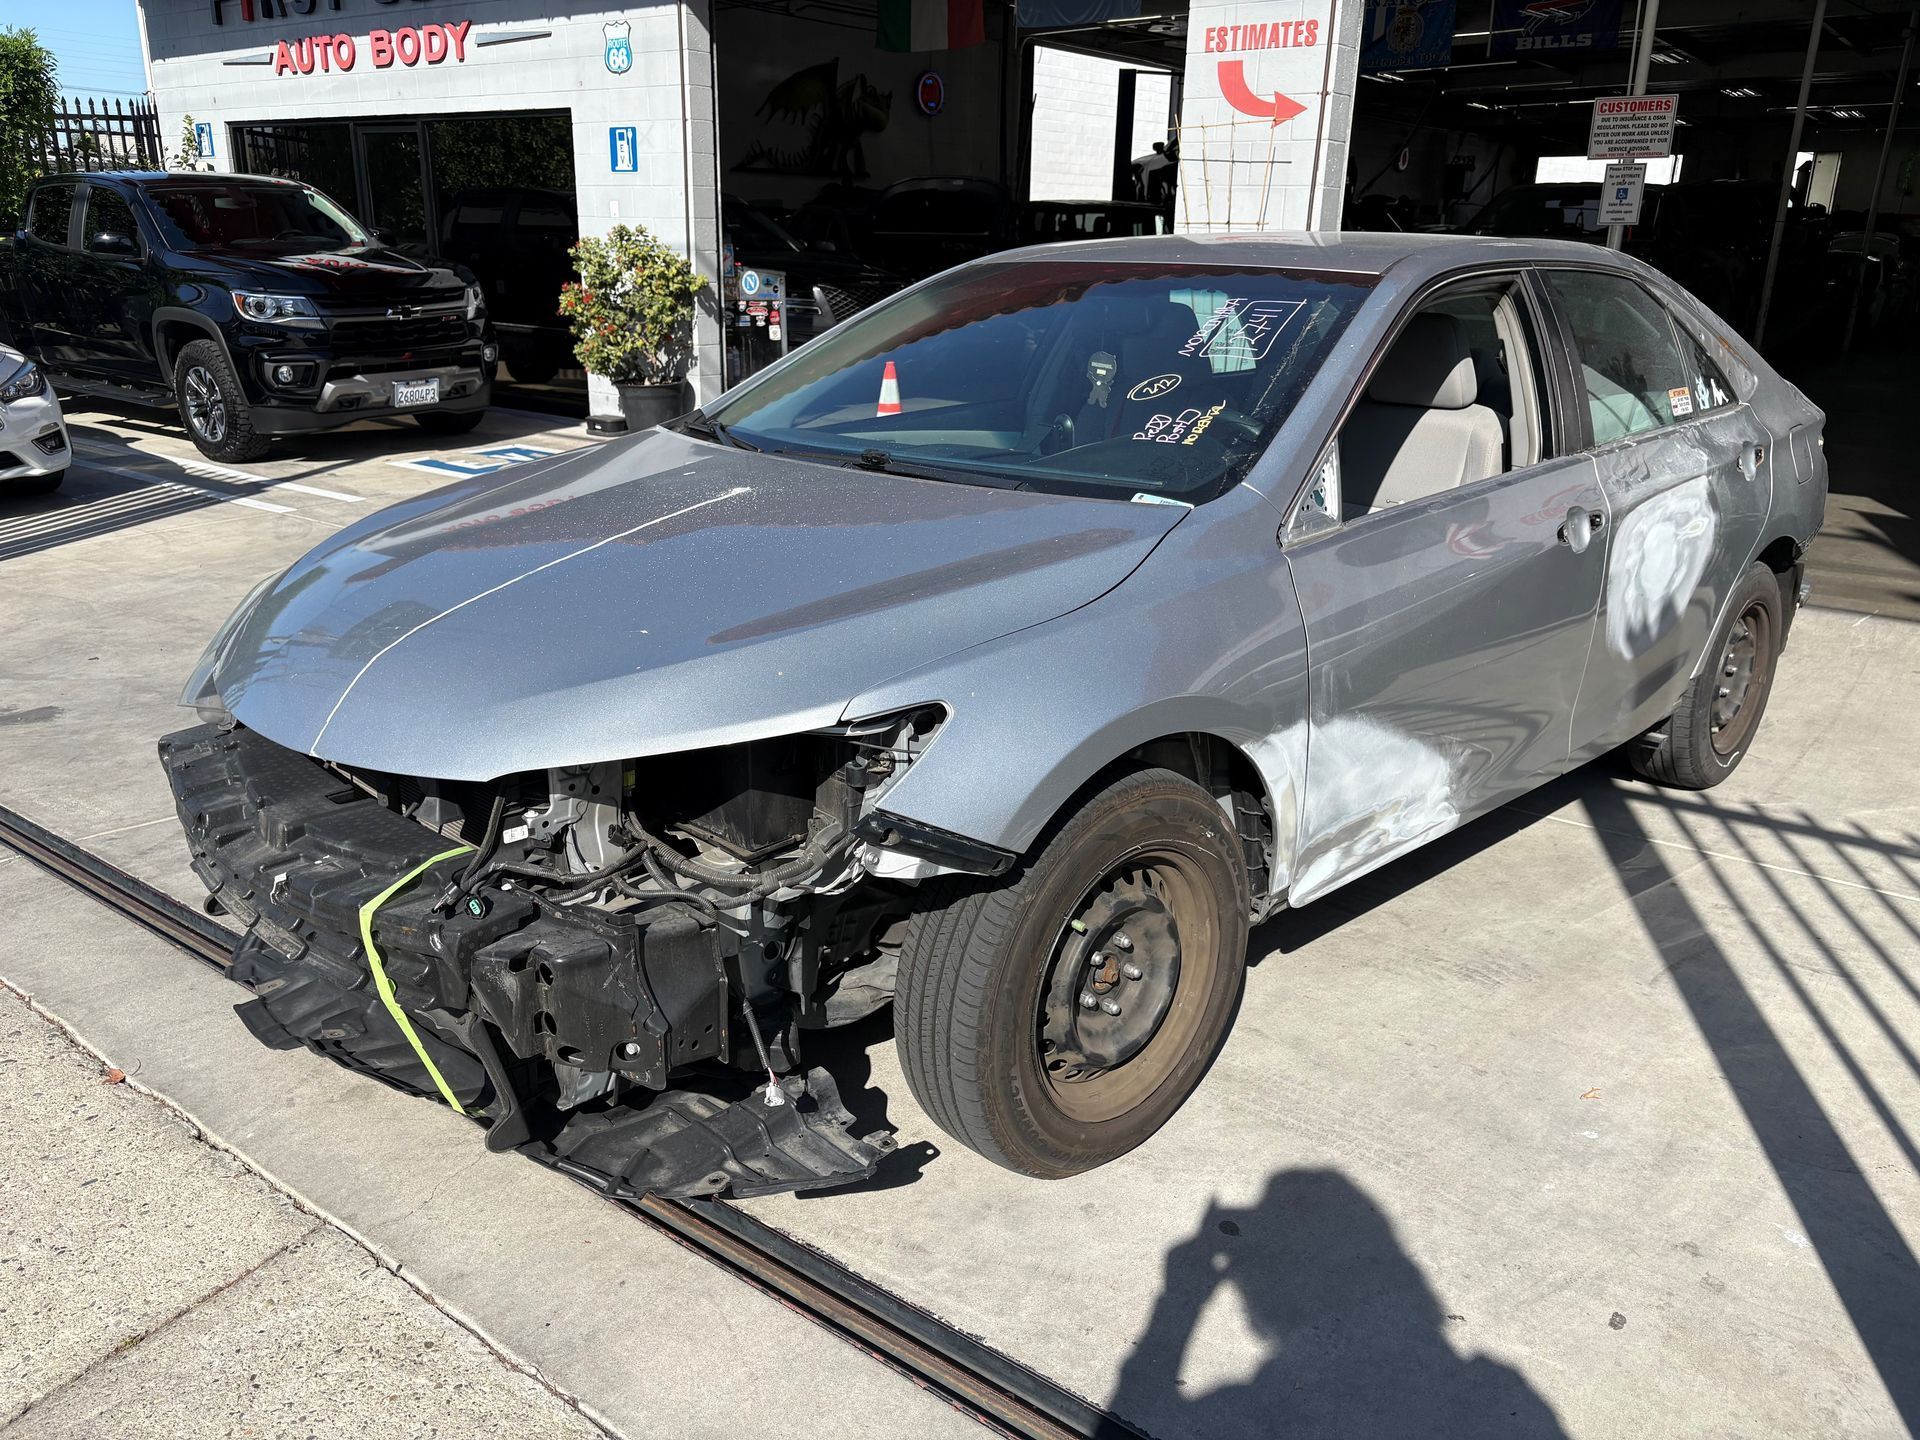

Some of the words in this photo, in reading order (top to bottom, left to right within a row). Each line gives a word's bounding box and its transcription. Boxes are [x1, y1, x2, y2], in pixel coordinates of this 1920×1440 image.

[608, 39, 628, 48] ROUTE
[1205, 18, 1319, 53] ESTIMATES
[1514, 32, 1593, 50] BILLS
[275, 33, 356, 76] AUTO
[369, 20, 472, 69] BODY
[609, 48, 628, 69] 66
[1599, 99, 1672, 113] CUSTOMERS
[398, 388, 436, 403] 26804P3
